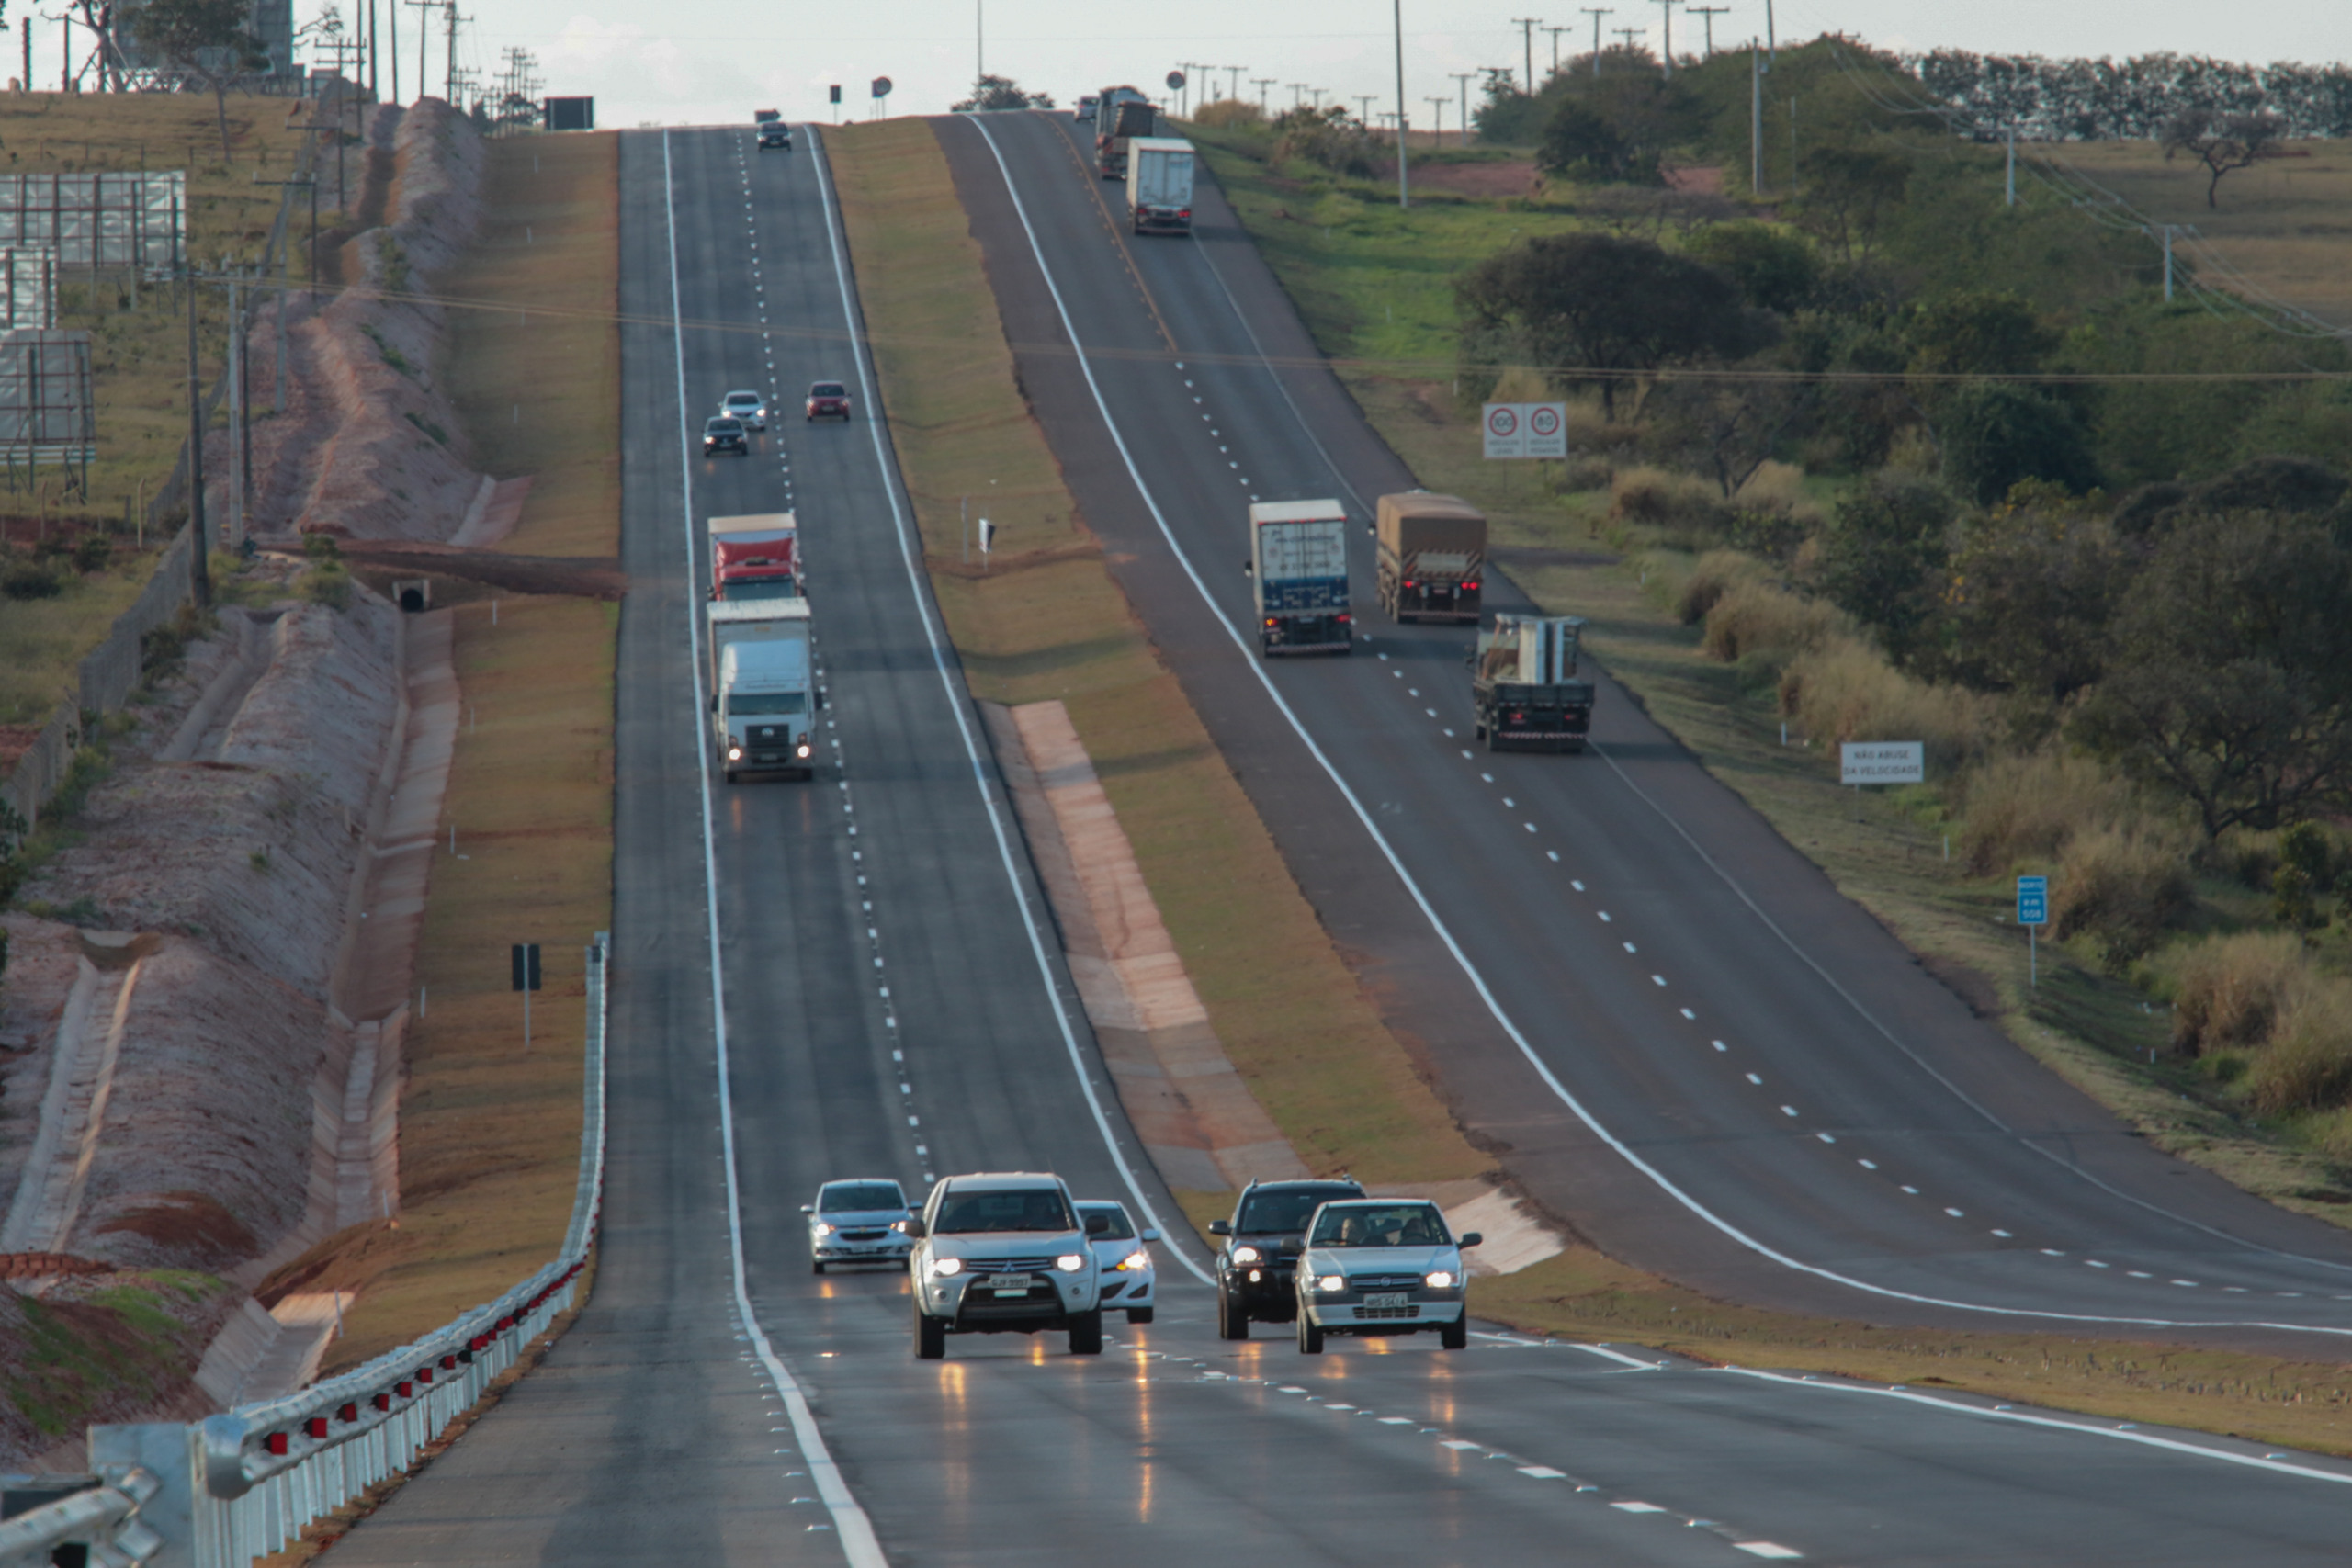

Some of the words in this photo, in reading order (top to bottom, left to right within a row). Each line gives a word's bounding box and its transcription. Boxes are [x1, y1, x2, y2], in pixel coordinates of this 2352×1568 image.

[1854, 749, 1875, 760] NÃO
[1877, 750, 1908, 760] ABUSE
[1843, 765, 1857, 774] DA
[1860, 764, 1920, 774] VELOCIDADE
